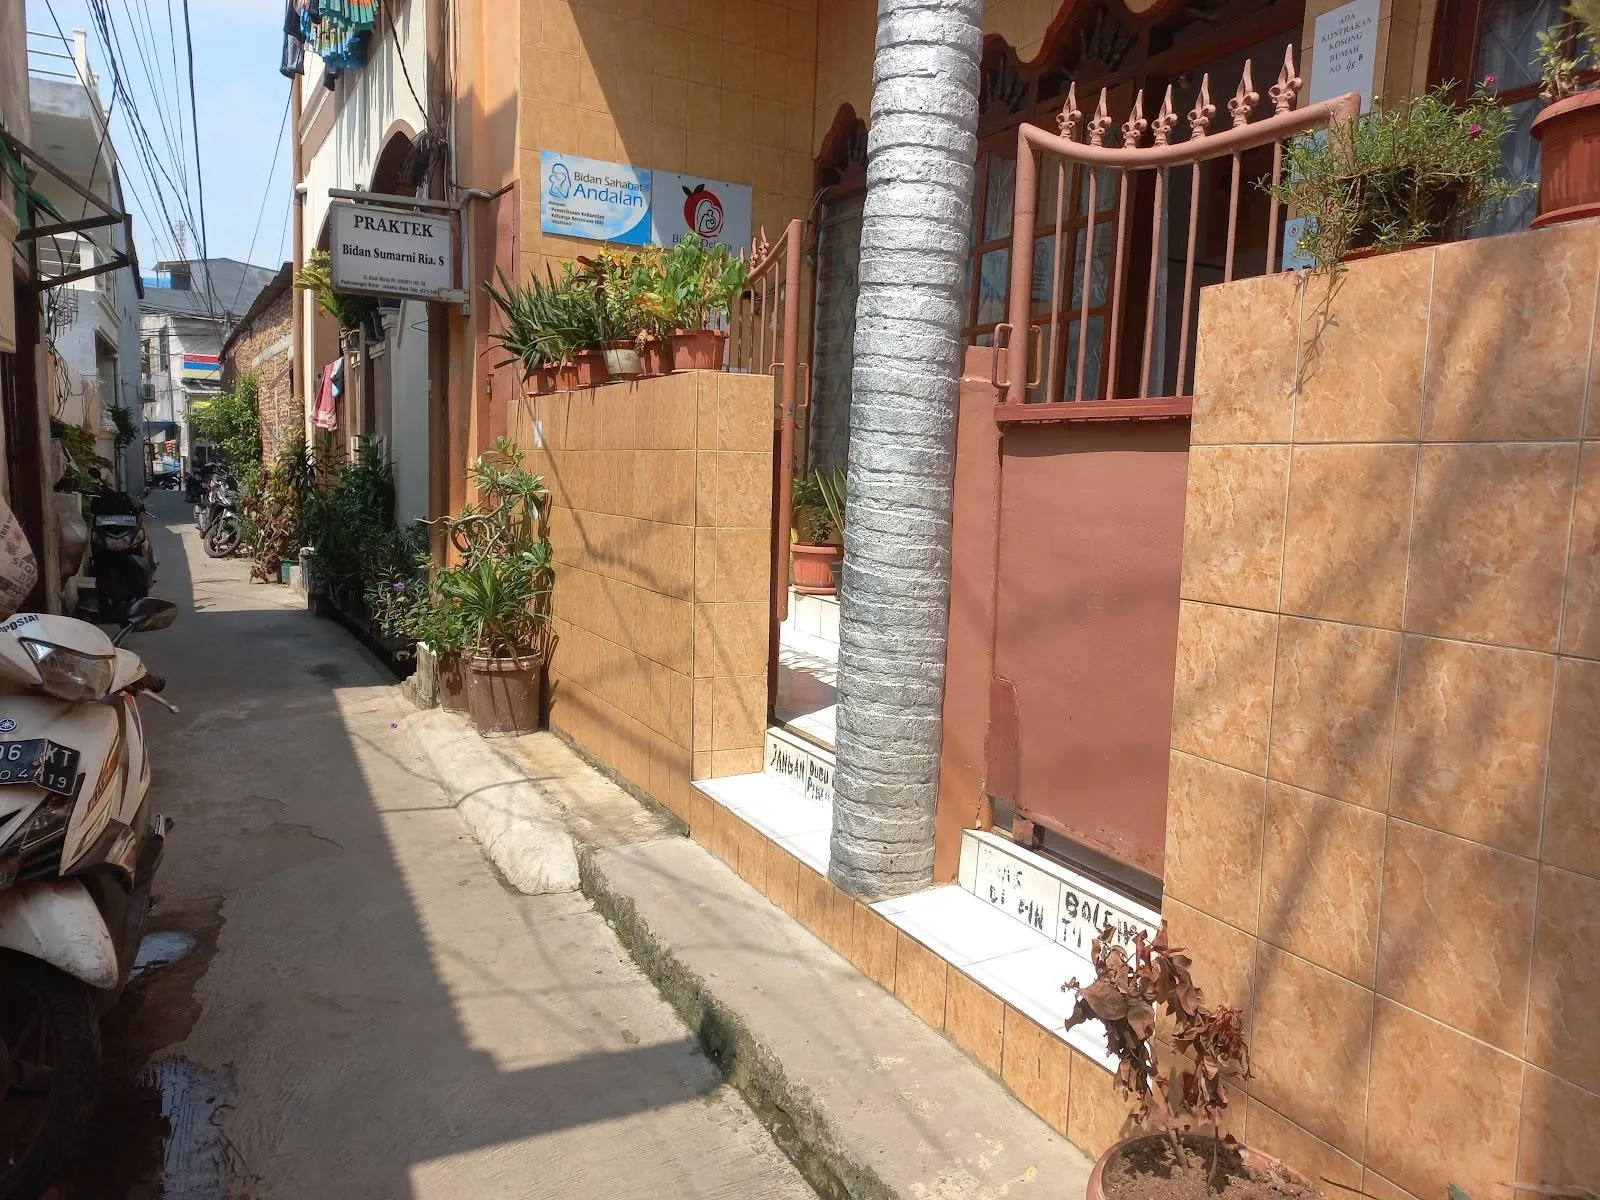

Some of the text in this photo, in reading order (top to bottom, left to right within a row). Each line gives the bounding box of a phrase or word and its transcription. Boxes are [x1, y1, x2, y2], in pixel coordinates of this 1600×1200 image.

[1339, 12, 1355, 24] ADA
[1321, 17, 1372, 43] KONTRAKAN
[1329, 31, 1362, 50] KOSONG
[1329, 45, 1359, 62] RUMAH
[573, 171, 643, 192] Bidan Sahabat
[573, 183, 643, 207] Andalan
[354, 214, 434, 238] PRAKTEK
[342, 243, 371, 258] Bidan
[373, 248, 416, 263] Sumarni
[438, 255, 445, 267] S
[45, 744, 73, 767] KT
[770, 743, 806, 782] JANGAN
